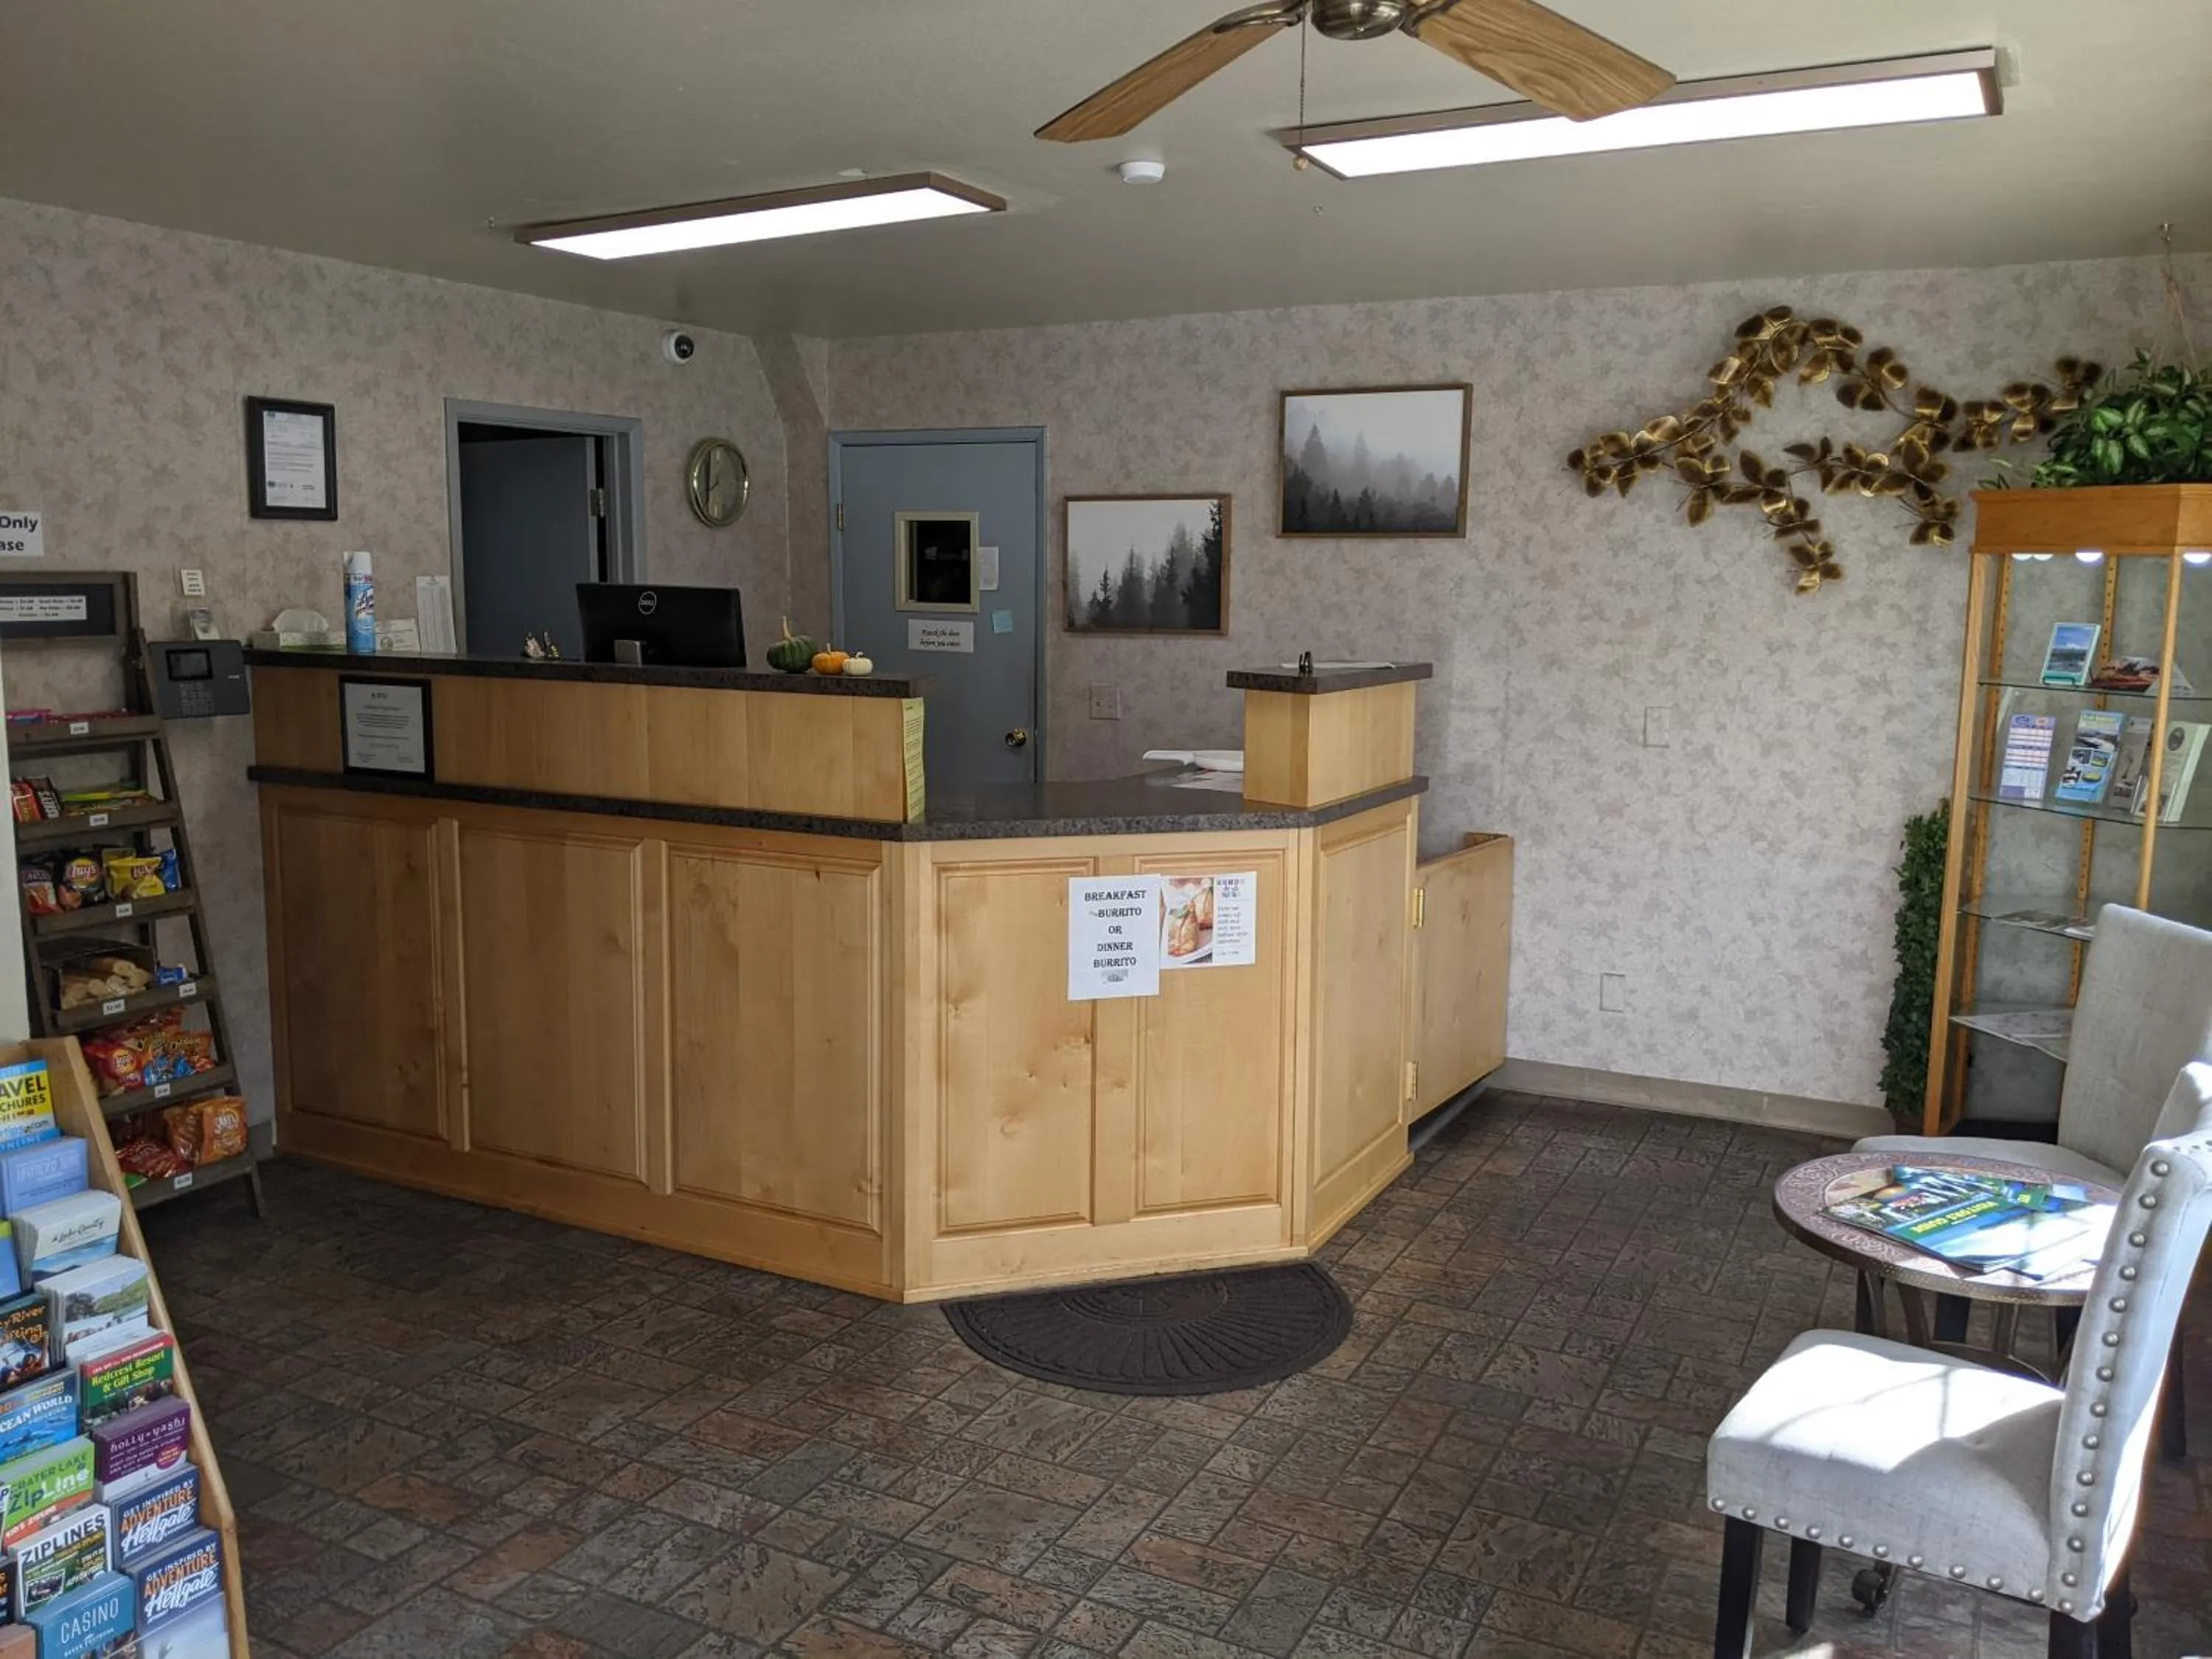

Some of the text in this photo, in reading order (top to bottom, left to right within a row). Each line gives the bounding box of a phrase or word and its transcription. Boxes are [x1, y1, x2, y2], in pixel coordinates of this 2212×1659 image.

[0, 515, 38, 533] Only
[1085, 890, 1147, 902] BREAKFAST
[1097, 908, 1142, 918] BURRITO
[1108, 925, 1122, 934] OR
[1096, 942, 1133, 952] DINNER
[1093, 958, 1137, 968] BURRITO
[32, 1394, 73, 1416] WORLD
[121, 1486, 195, 1534] ADVENTURE
[21, 1514, 105, 1566] ZIPLINES
[144, 1551, 216, 1599] ADVENTURE
[60, 1597, 119, 1644] CASINO
